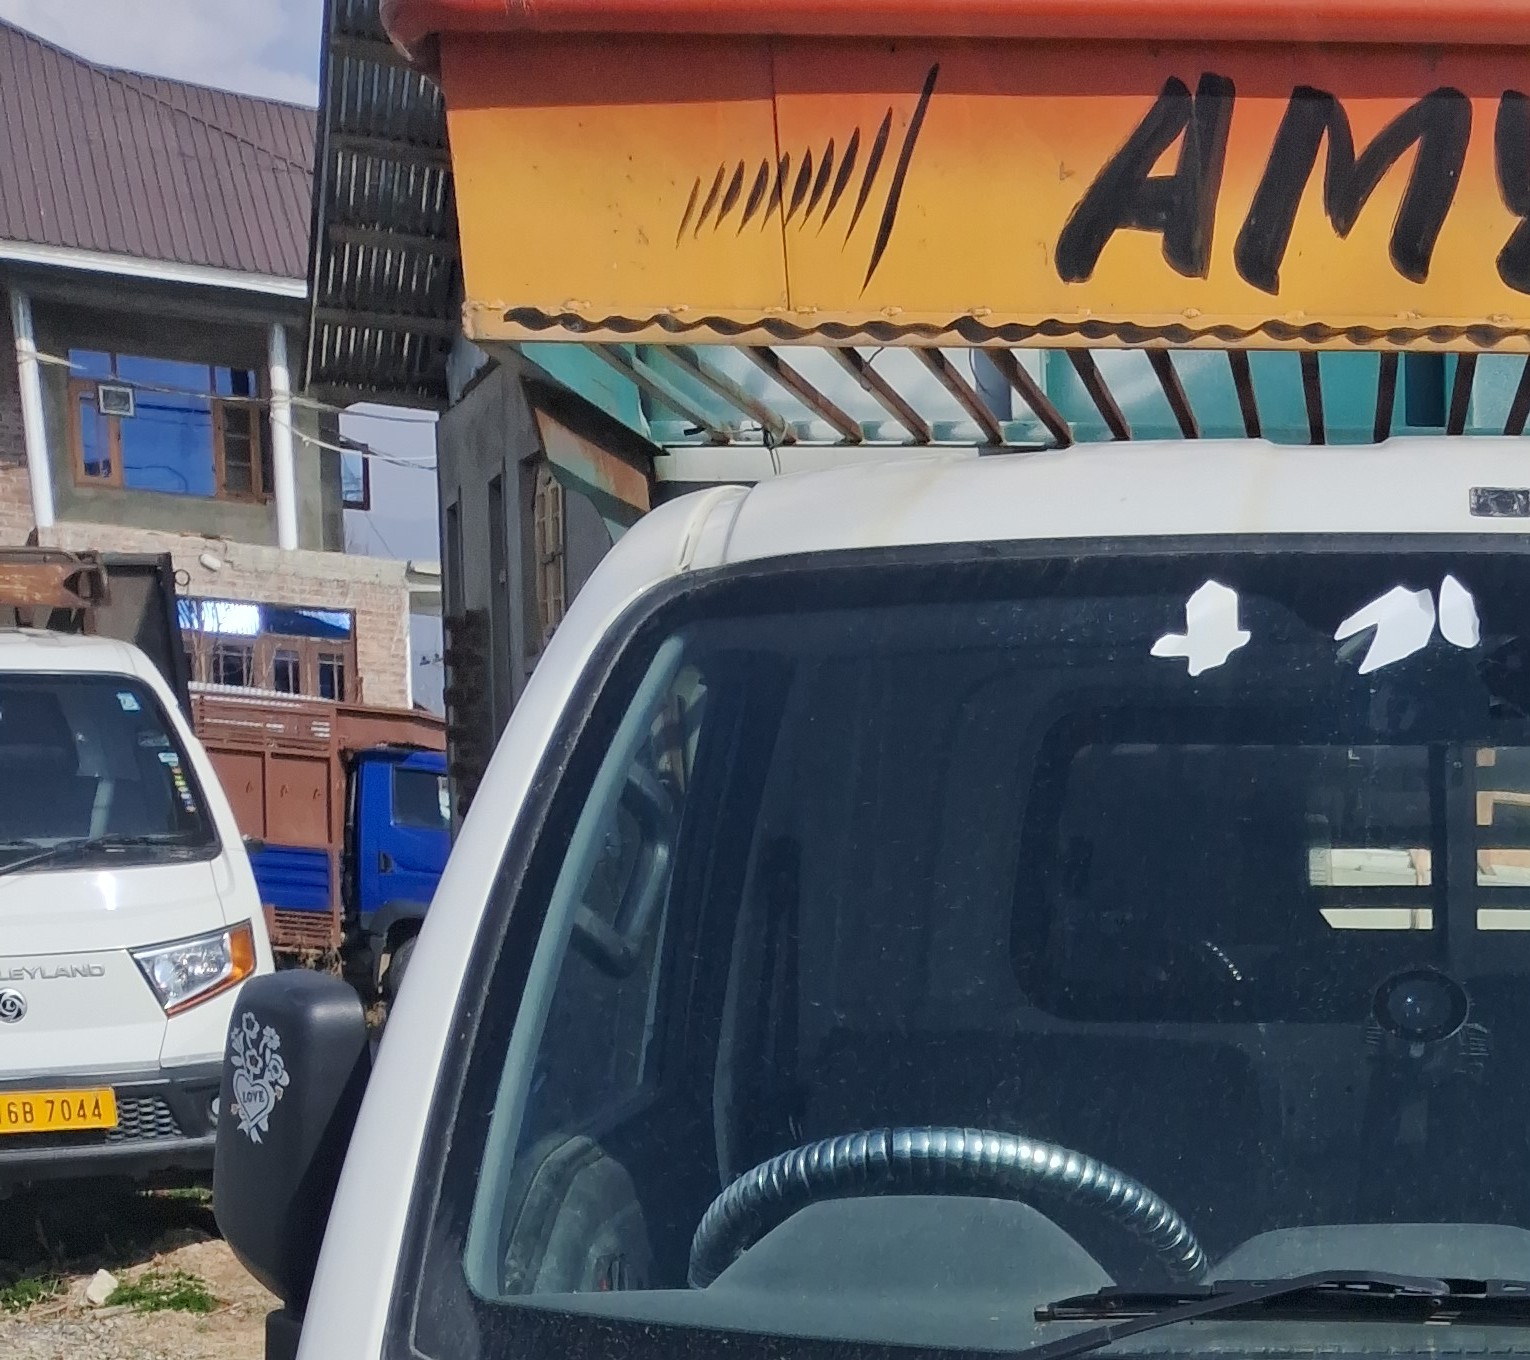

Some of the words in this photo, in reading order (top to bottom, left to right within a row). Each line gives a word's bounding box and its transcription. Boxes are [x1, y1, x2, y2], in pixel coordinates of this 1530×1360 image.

[242, 1090, 265, 1103] LOVE
[0, 1100, 34, 1125] 6B
[45, 1097, 102, 1122] 7044
